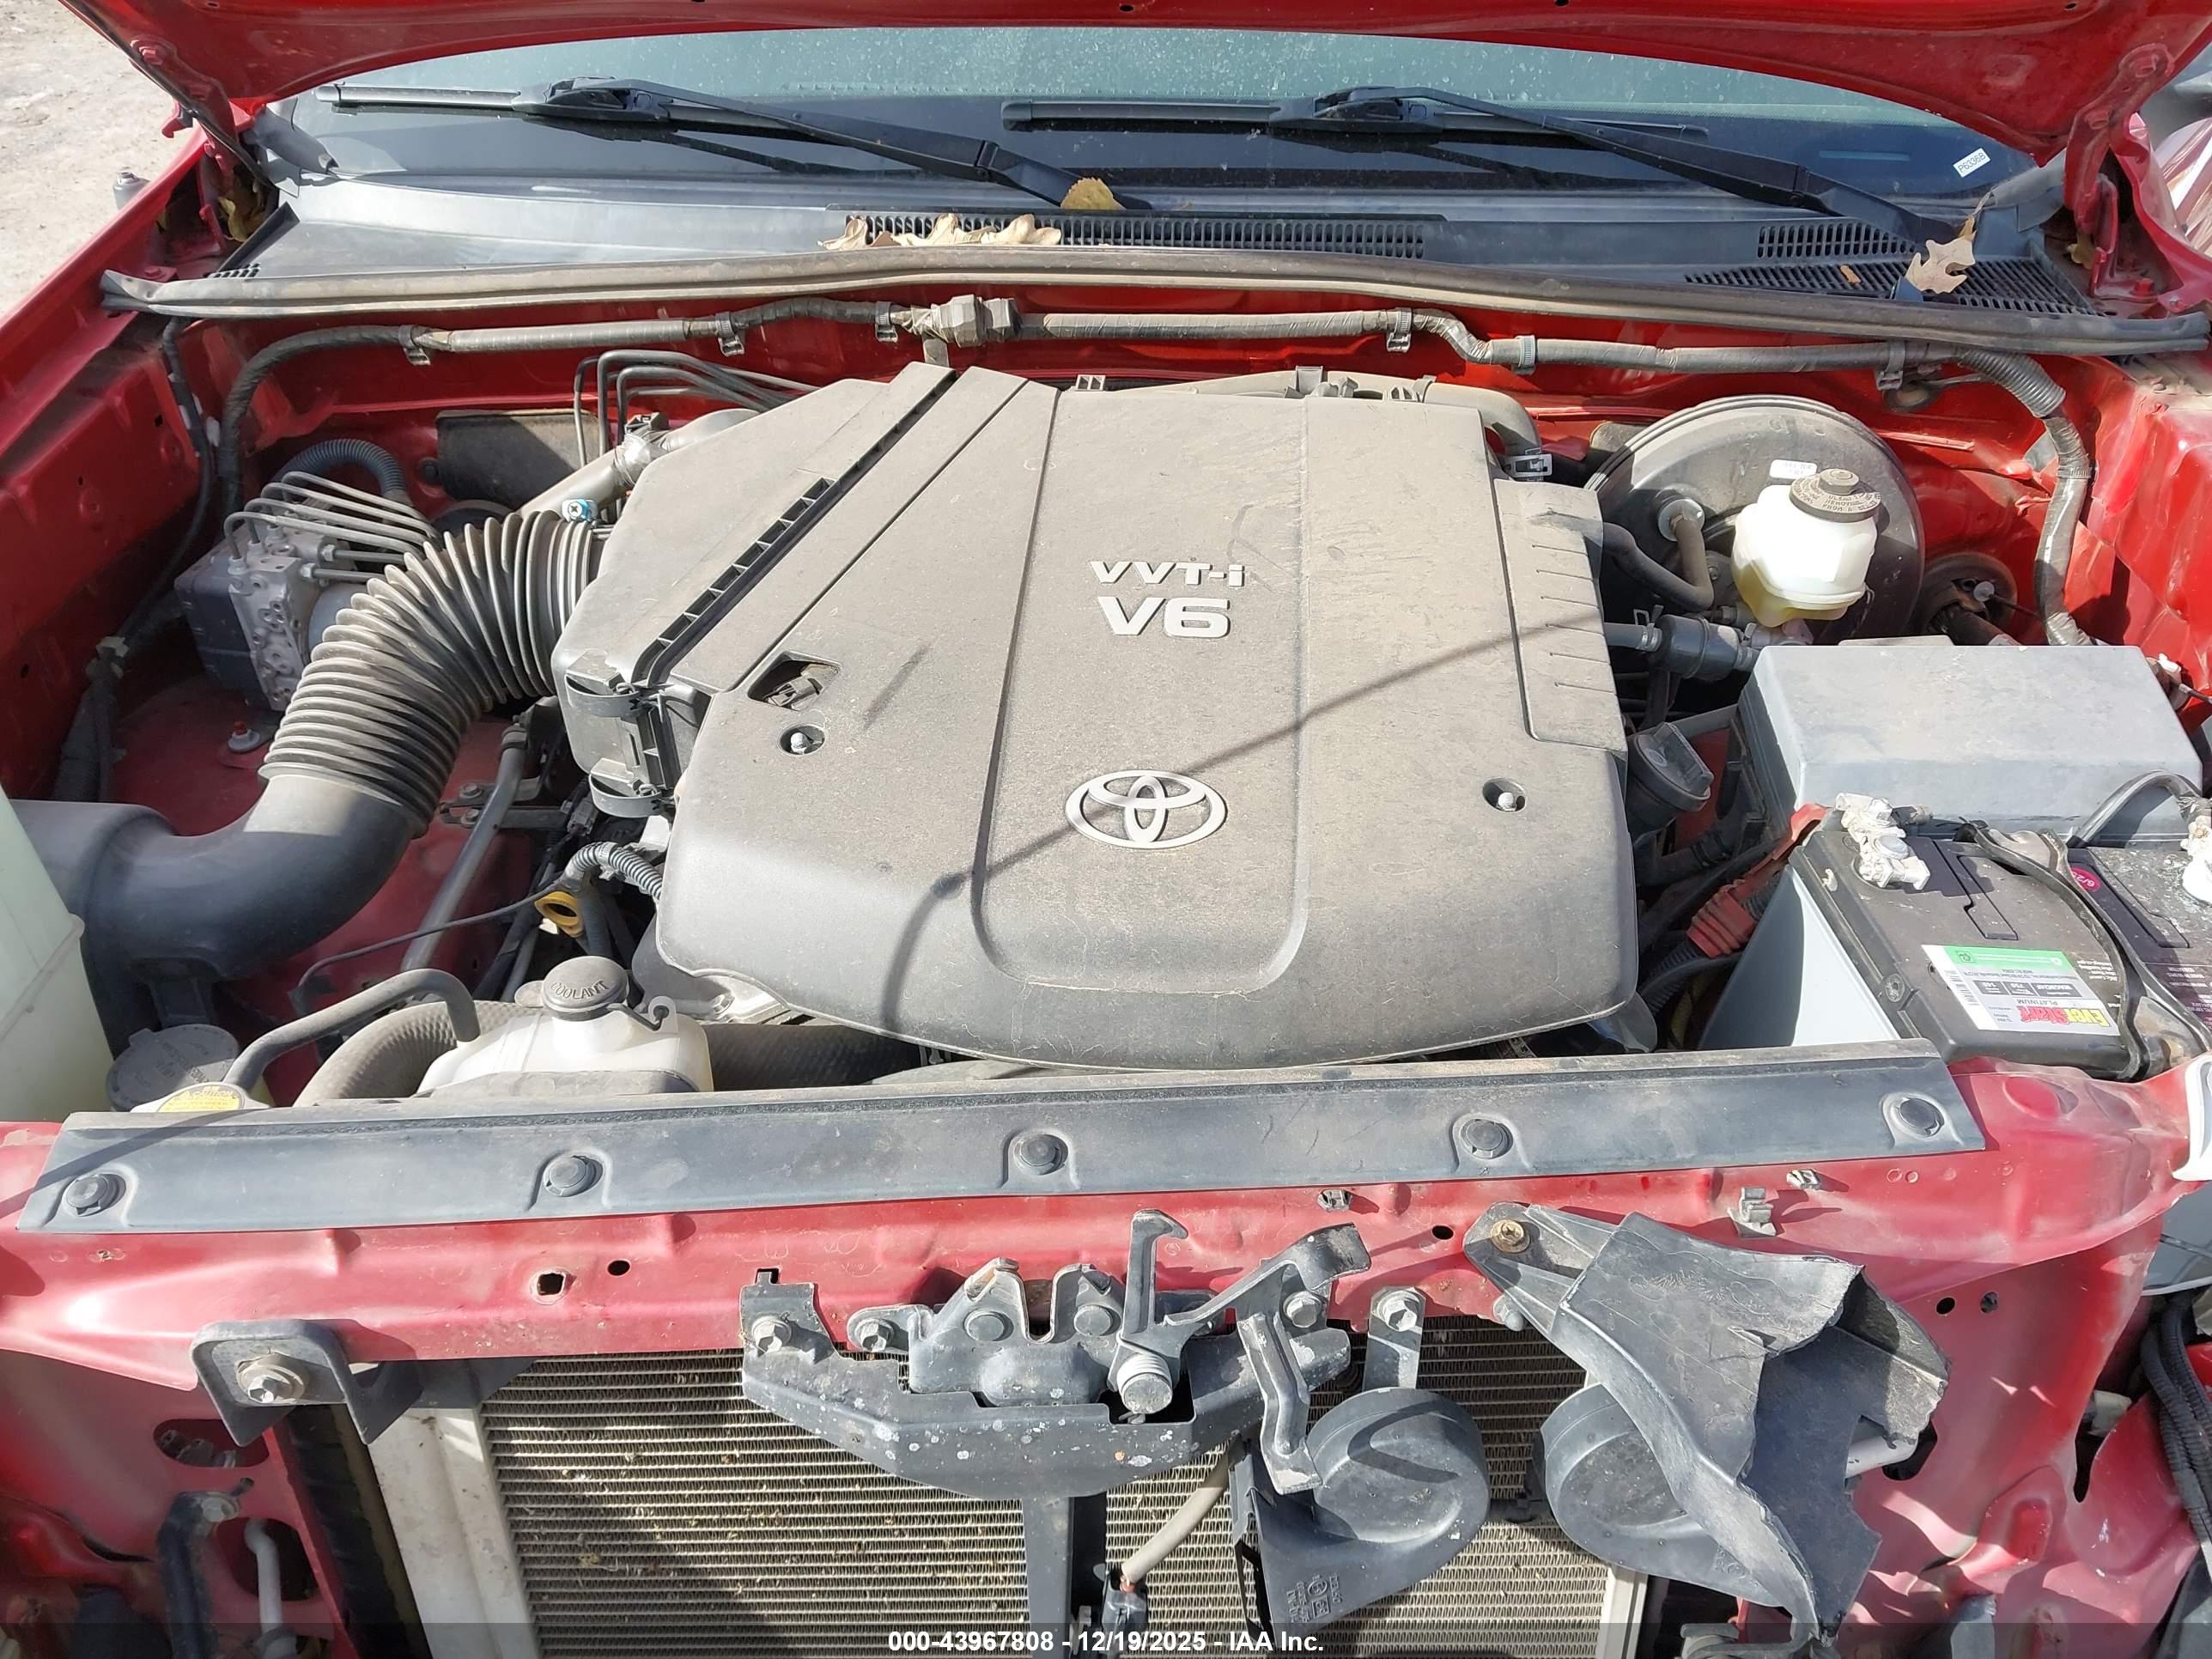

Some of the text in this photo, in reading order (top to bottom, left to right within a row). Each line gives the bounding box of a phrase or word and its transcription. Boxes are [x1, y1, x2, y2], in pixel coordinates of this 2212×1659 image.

[1090, 560, 1245, 587] VVT-i
[1097, 596, 1231, 638] V6
[550, 980, 611, 1000] COOLANT
[2016, 998, 2059, 1006] PLATINUM
[2019, 1006, 2111, 1027] EverStart
